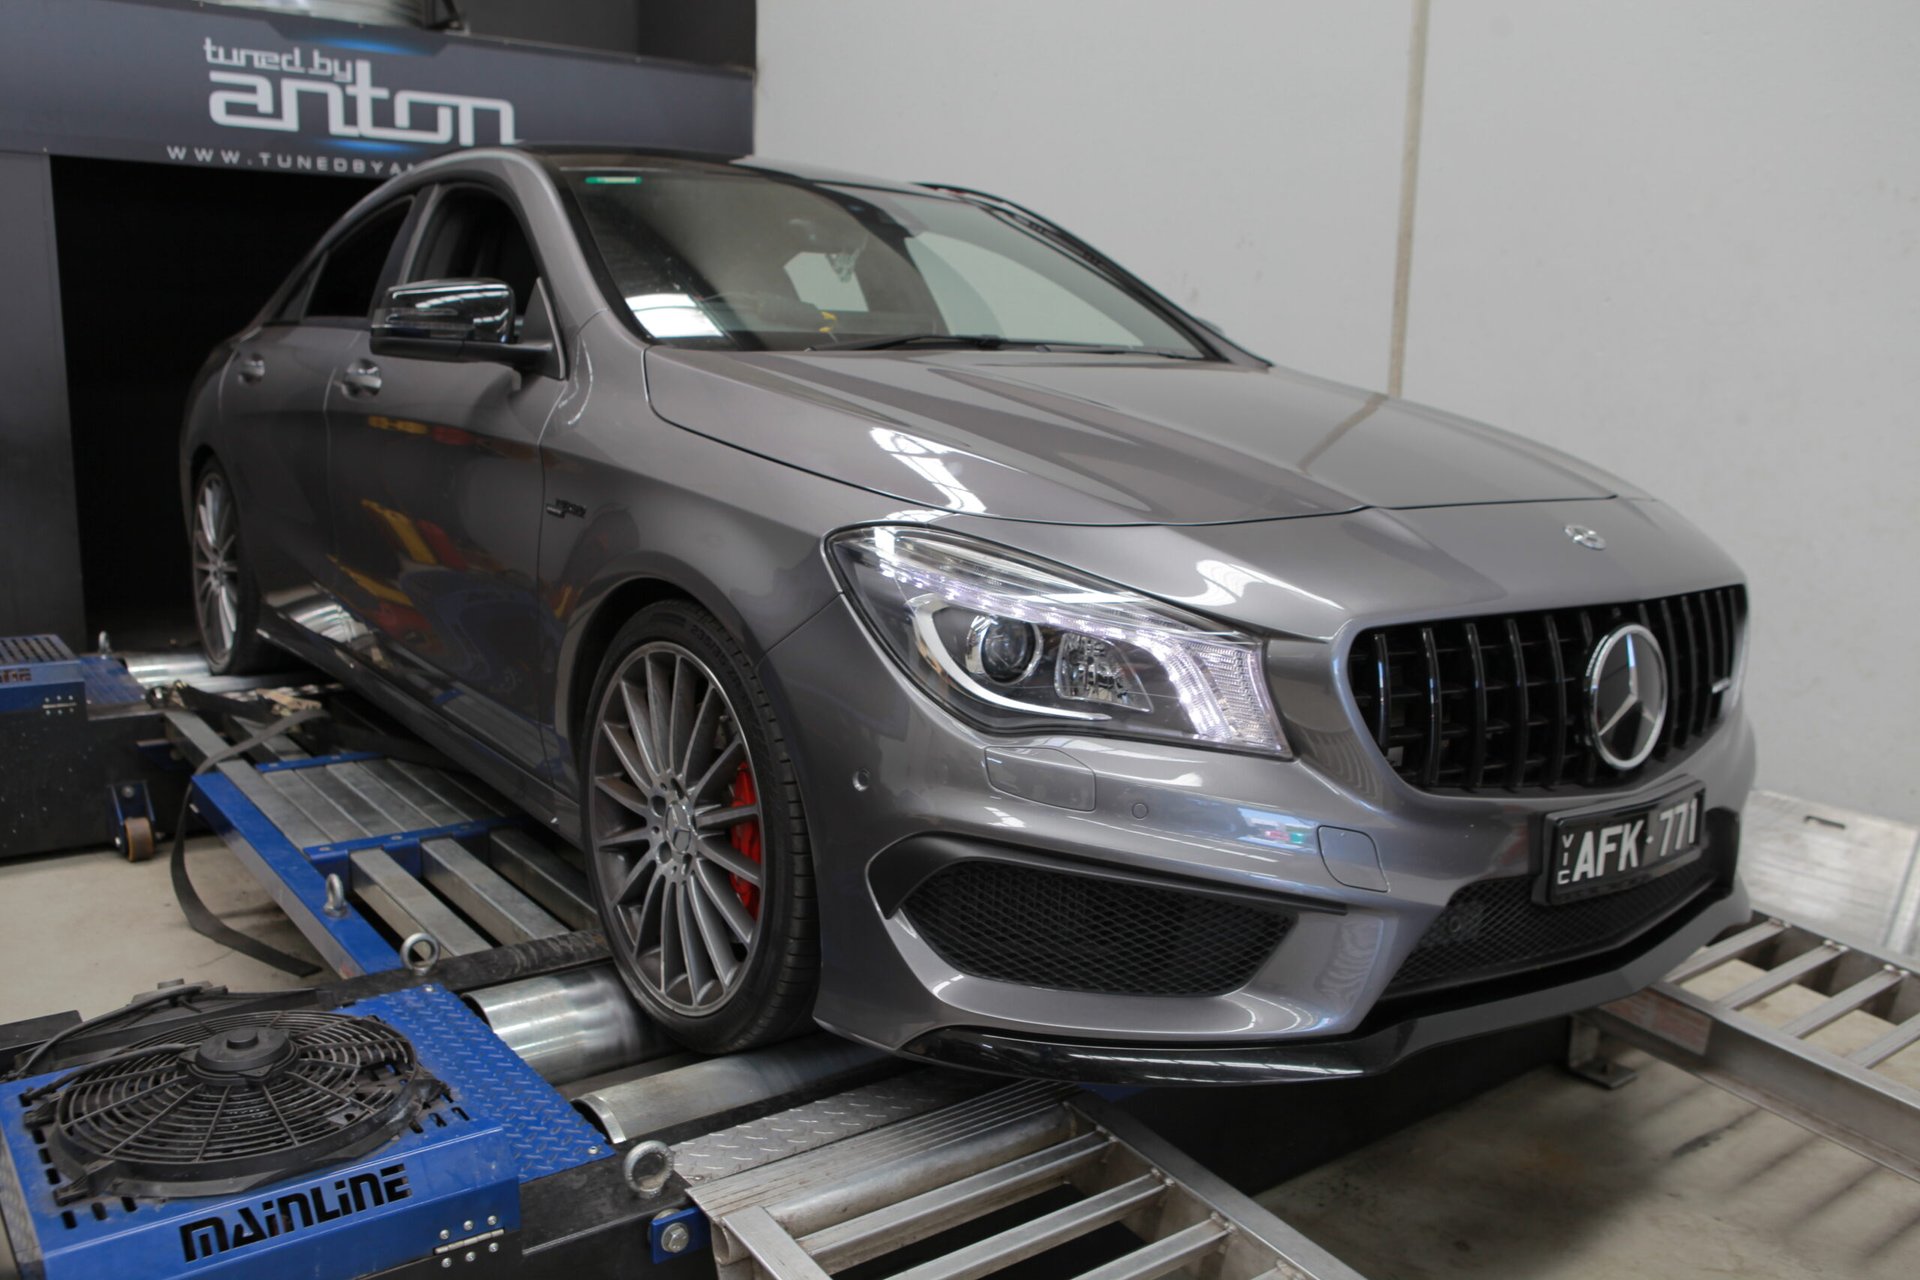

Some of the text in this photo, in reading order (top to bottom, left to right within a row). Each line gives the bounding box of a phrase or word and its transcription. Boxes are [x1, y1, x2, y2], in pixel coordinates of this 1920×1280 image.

[203, 37, 353, 82] tuned by
[208, 59, 515, 147] anton
[1557, 834, 1575, 885] VIC
